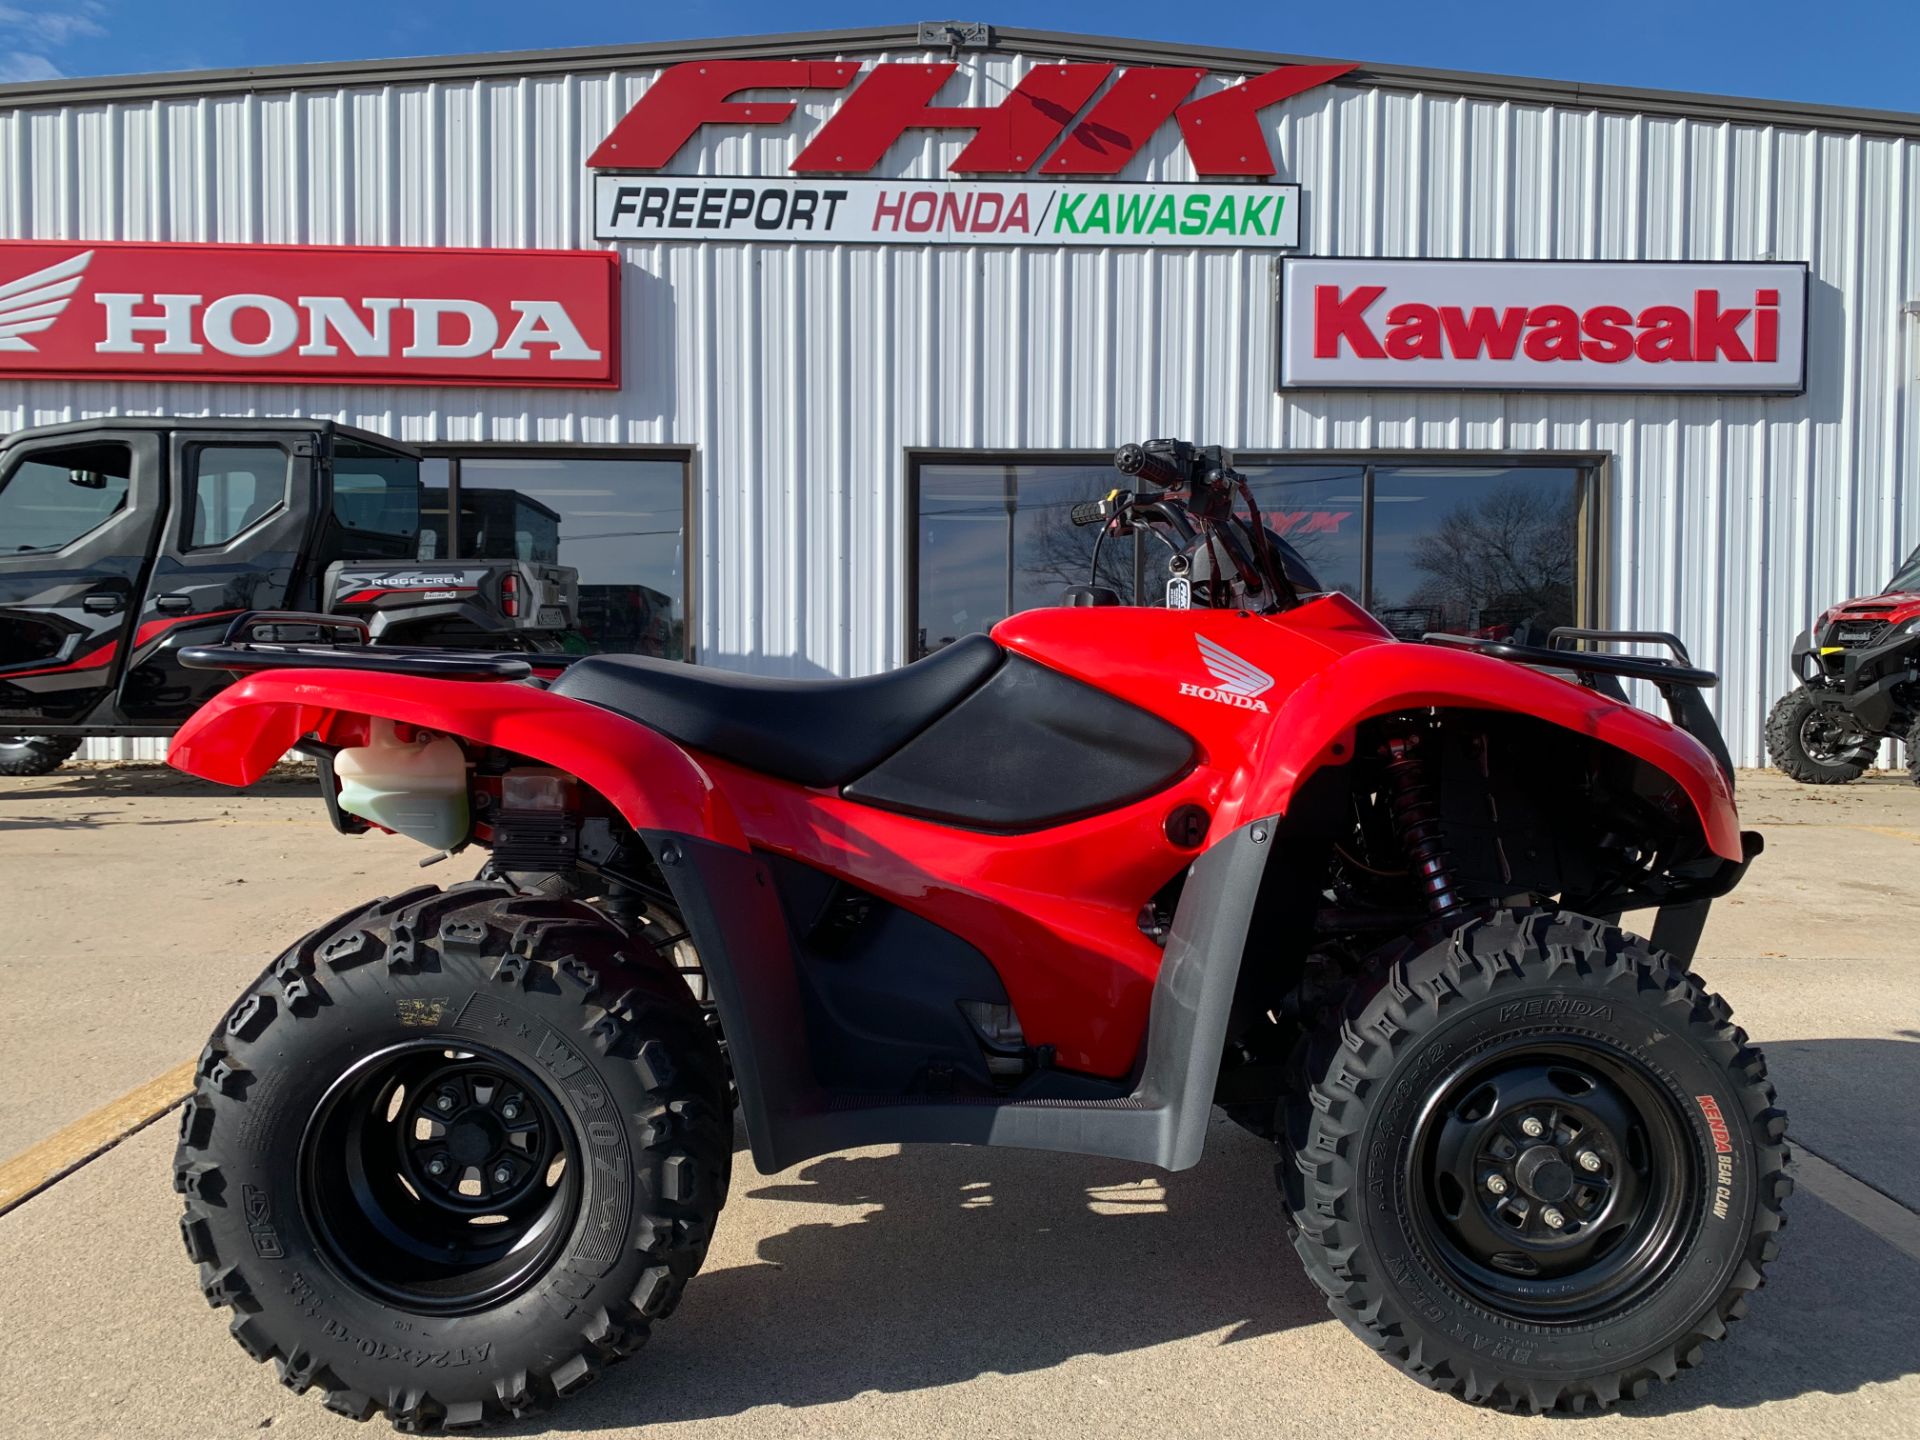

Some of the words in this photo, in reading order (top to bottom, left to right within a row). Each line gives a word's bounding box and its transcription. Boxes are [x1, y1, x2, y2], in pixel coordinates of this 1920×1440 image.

[586, 59, 1361, 176] FHK
[610, 187, 847, 230] FREEPORT
[94, 293, 602, 361] HONDA
[1314, 285, 1779, 363] Kawasaki
[371, 576, 419, 585] RIDGE
[422, 576, 464, 584] CREW
[1179, 682, 1270, 714] HONDA
[1499, 998, 1614, 1022] KENDA
[1695, 1094, 1733, 1153] KENDA
[1717, 1154, 1732, 1186] BEAR
[1712, 1186, 1731, 1220] CLAW
